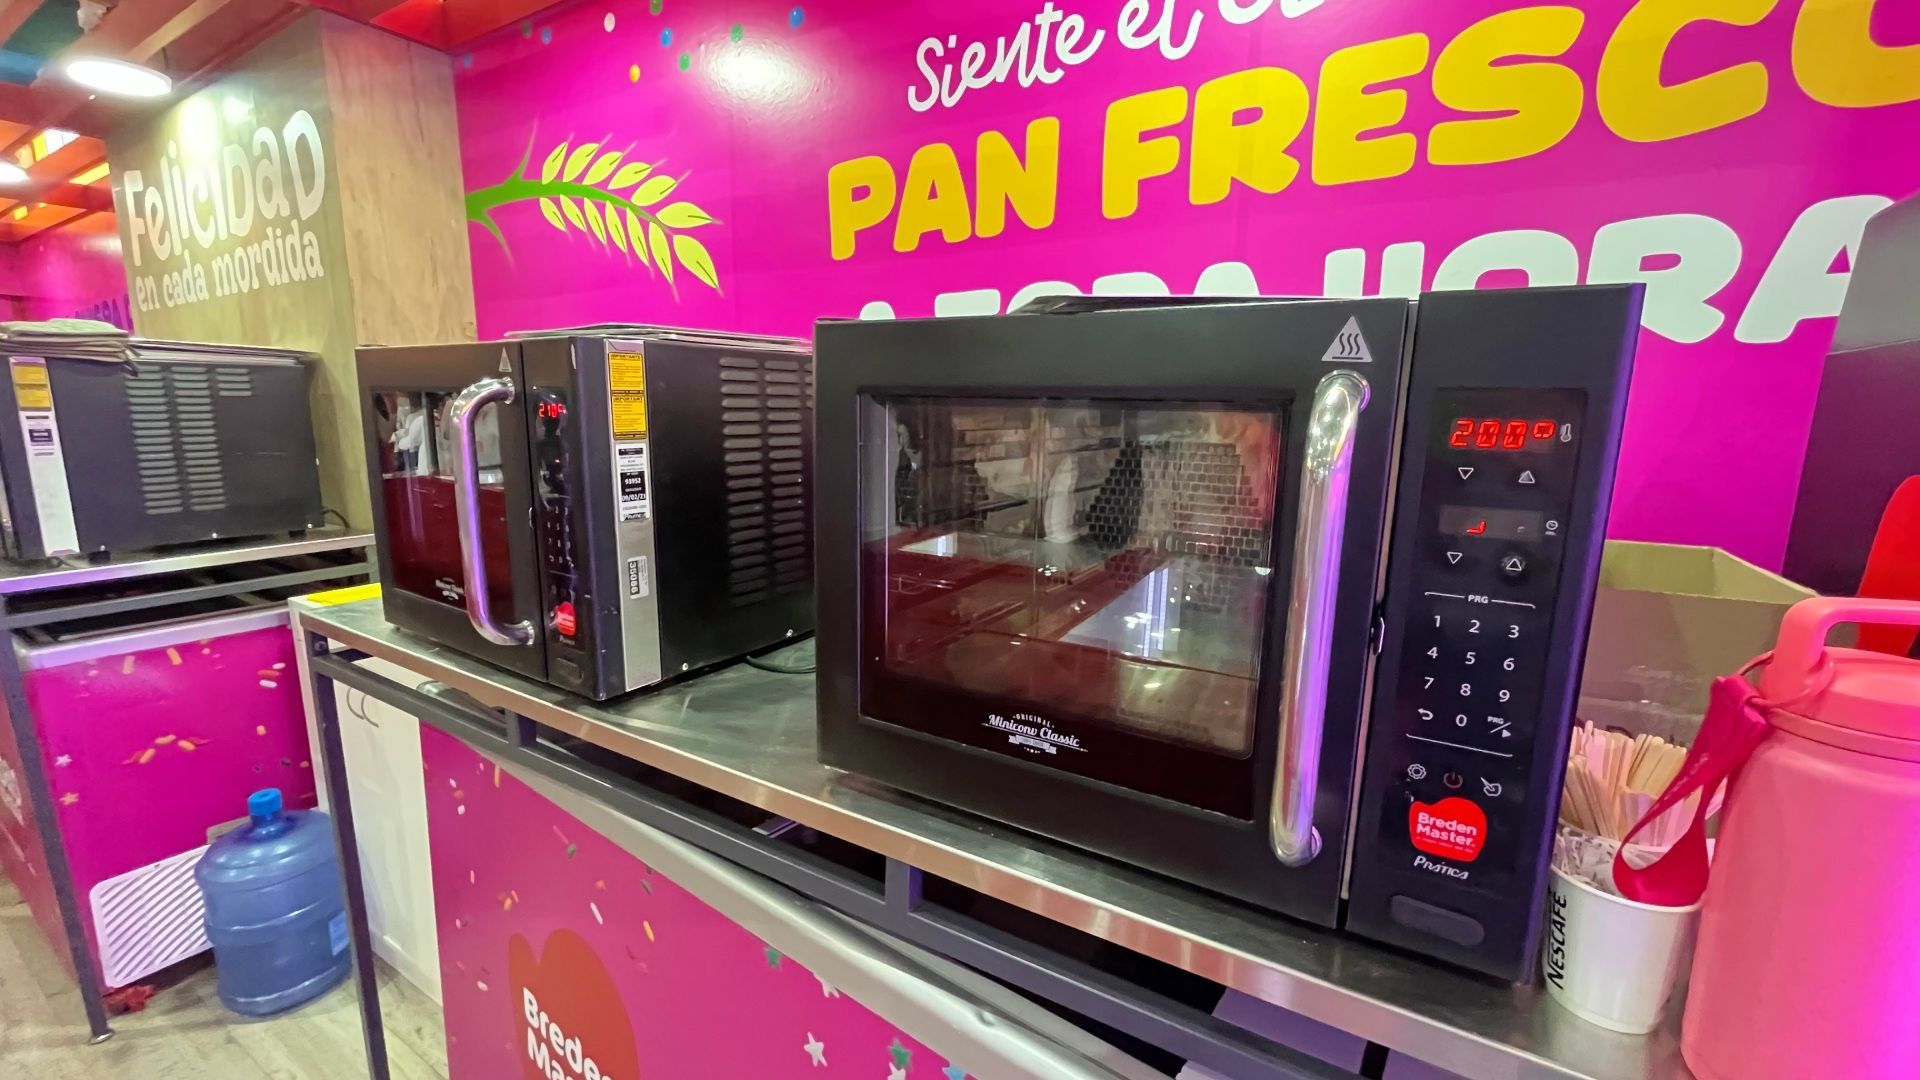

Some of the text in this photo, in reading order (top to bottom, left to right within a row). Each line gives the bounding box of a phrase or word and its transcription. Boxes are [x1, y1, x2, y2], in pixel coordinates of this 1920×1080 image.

[908, 2, 1106, 112] Siente
[828, 116, 1060, 261] PAN
[135, 219, 325, 312] en cada mordida
[1467, 594, 1489, 604] PRG
[1433, 615, 1520, 639] 1 2 3
[1426, 646, 1515, 671] 4 5 6
[1424, 676, 1510, 702] 7 8 9
[988, 714, 1038, 736] Miniconv
[1039, 727, 1081, 747] Classic
[1015, 713, 1051, 728] ORIGINAL
[1455, 714, 1505, 727] 0 PRG
[1417, 812, 1478, 836] Breden
[528, 1027, 574, 1080] Ma
